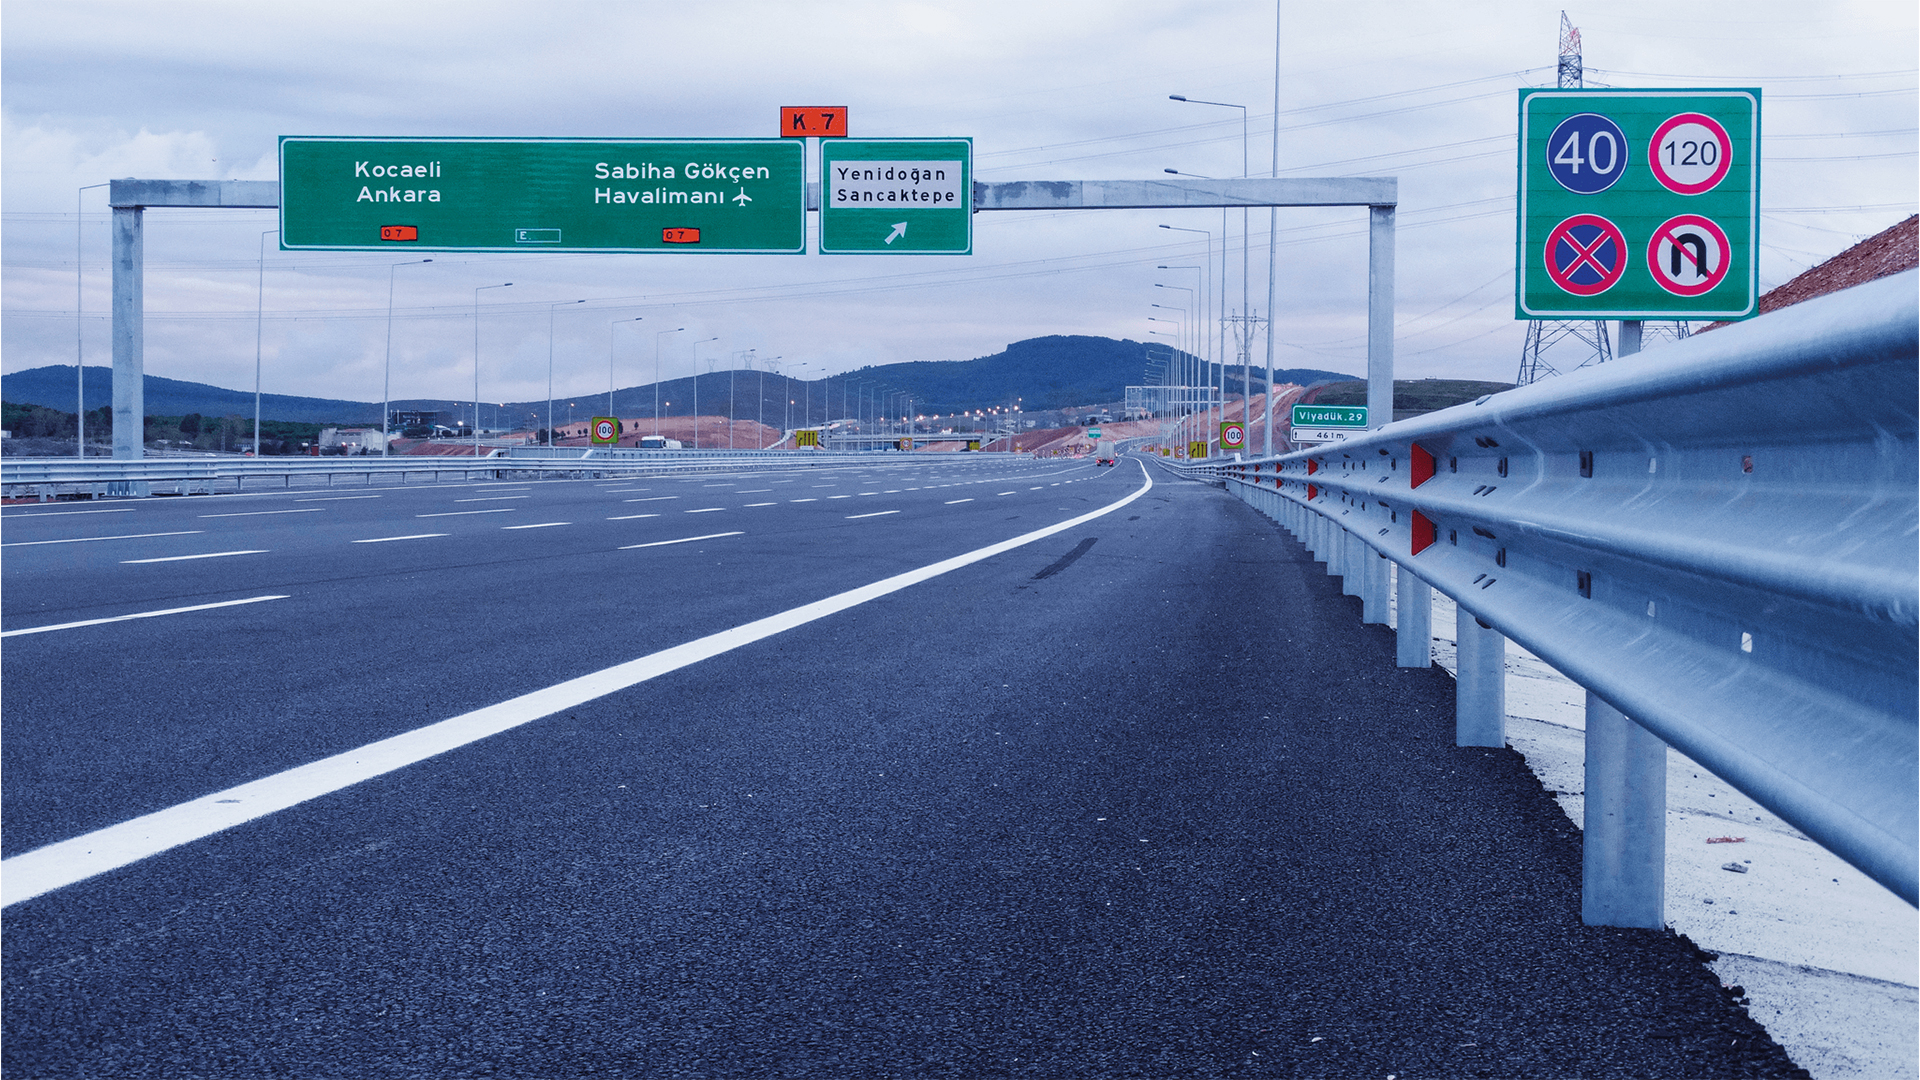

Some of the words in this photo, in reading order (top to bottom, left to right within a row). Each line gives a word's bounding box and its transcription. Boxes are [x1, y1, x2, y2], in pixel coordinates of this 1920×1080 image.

[1553, 130, 1618, 175] 40
[1665, 141, 1717, 166] 120
[355, 161, 441, 178] Kocaeli
[595, 162, 675, 179] Sabiha
[685, 162, 770, 183] Gökçen
[837, 168, 946, 184] Yenidoğan
[356, 186, 442, 203] Ankara
[595, 187, 724, 204] Havalimanı
[837, 188, 955, 205] Sancaktepe
[598, 426, 612, 434] 100
[1227, 431, 1241, 440] 100
